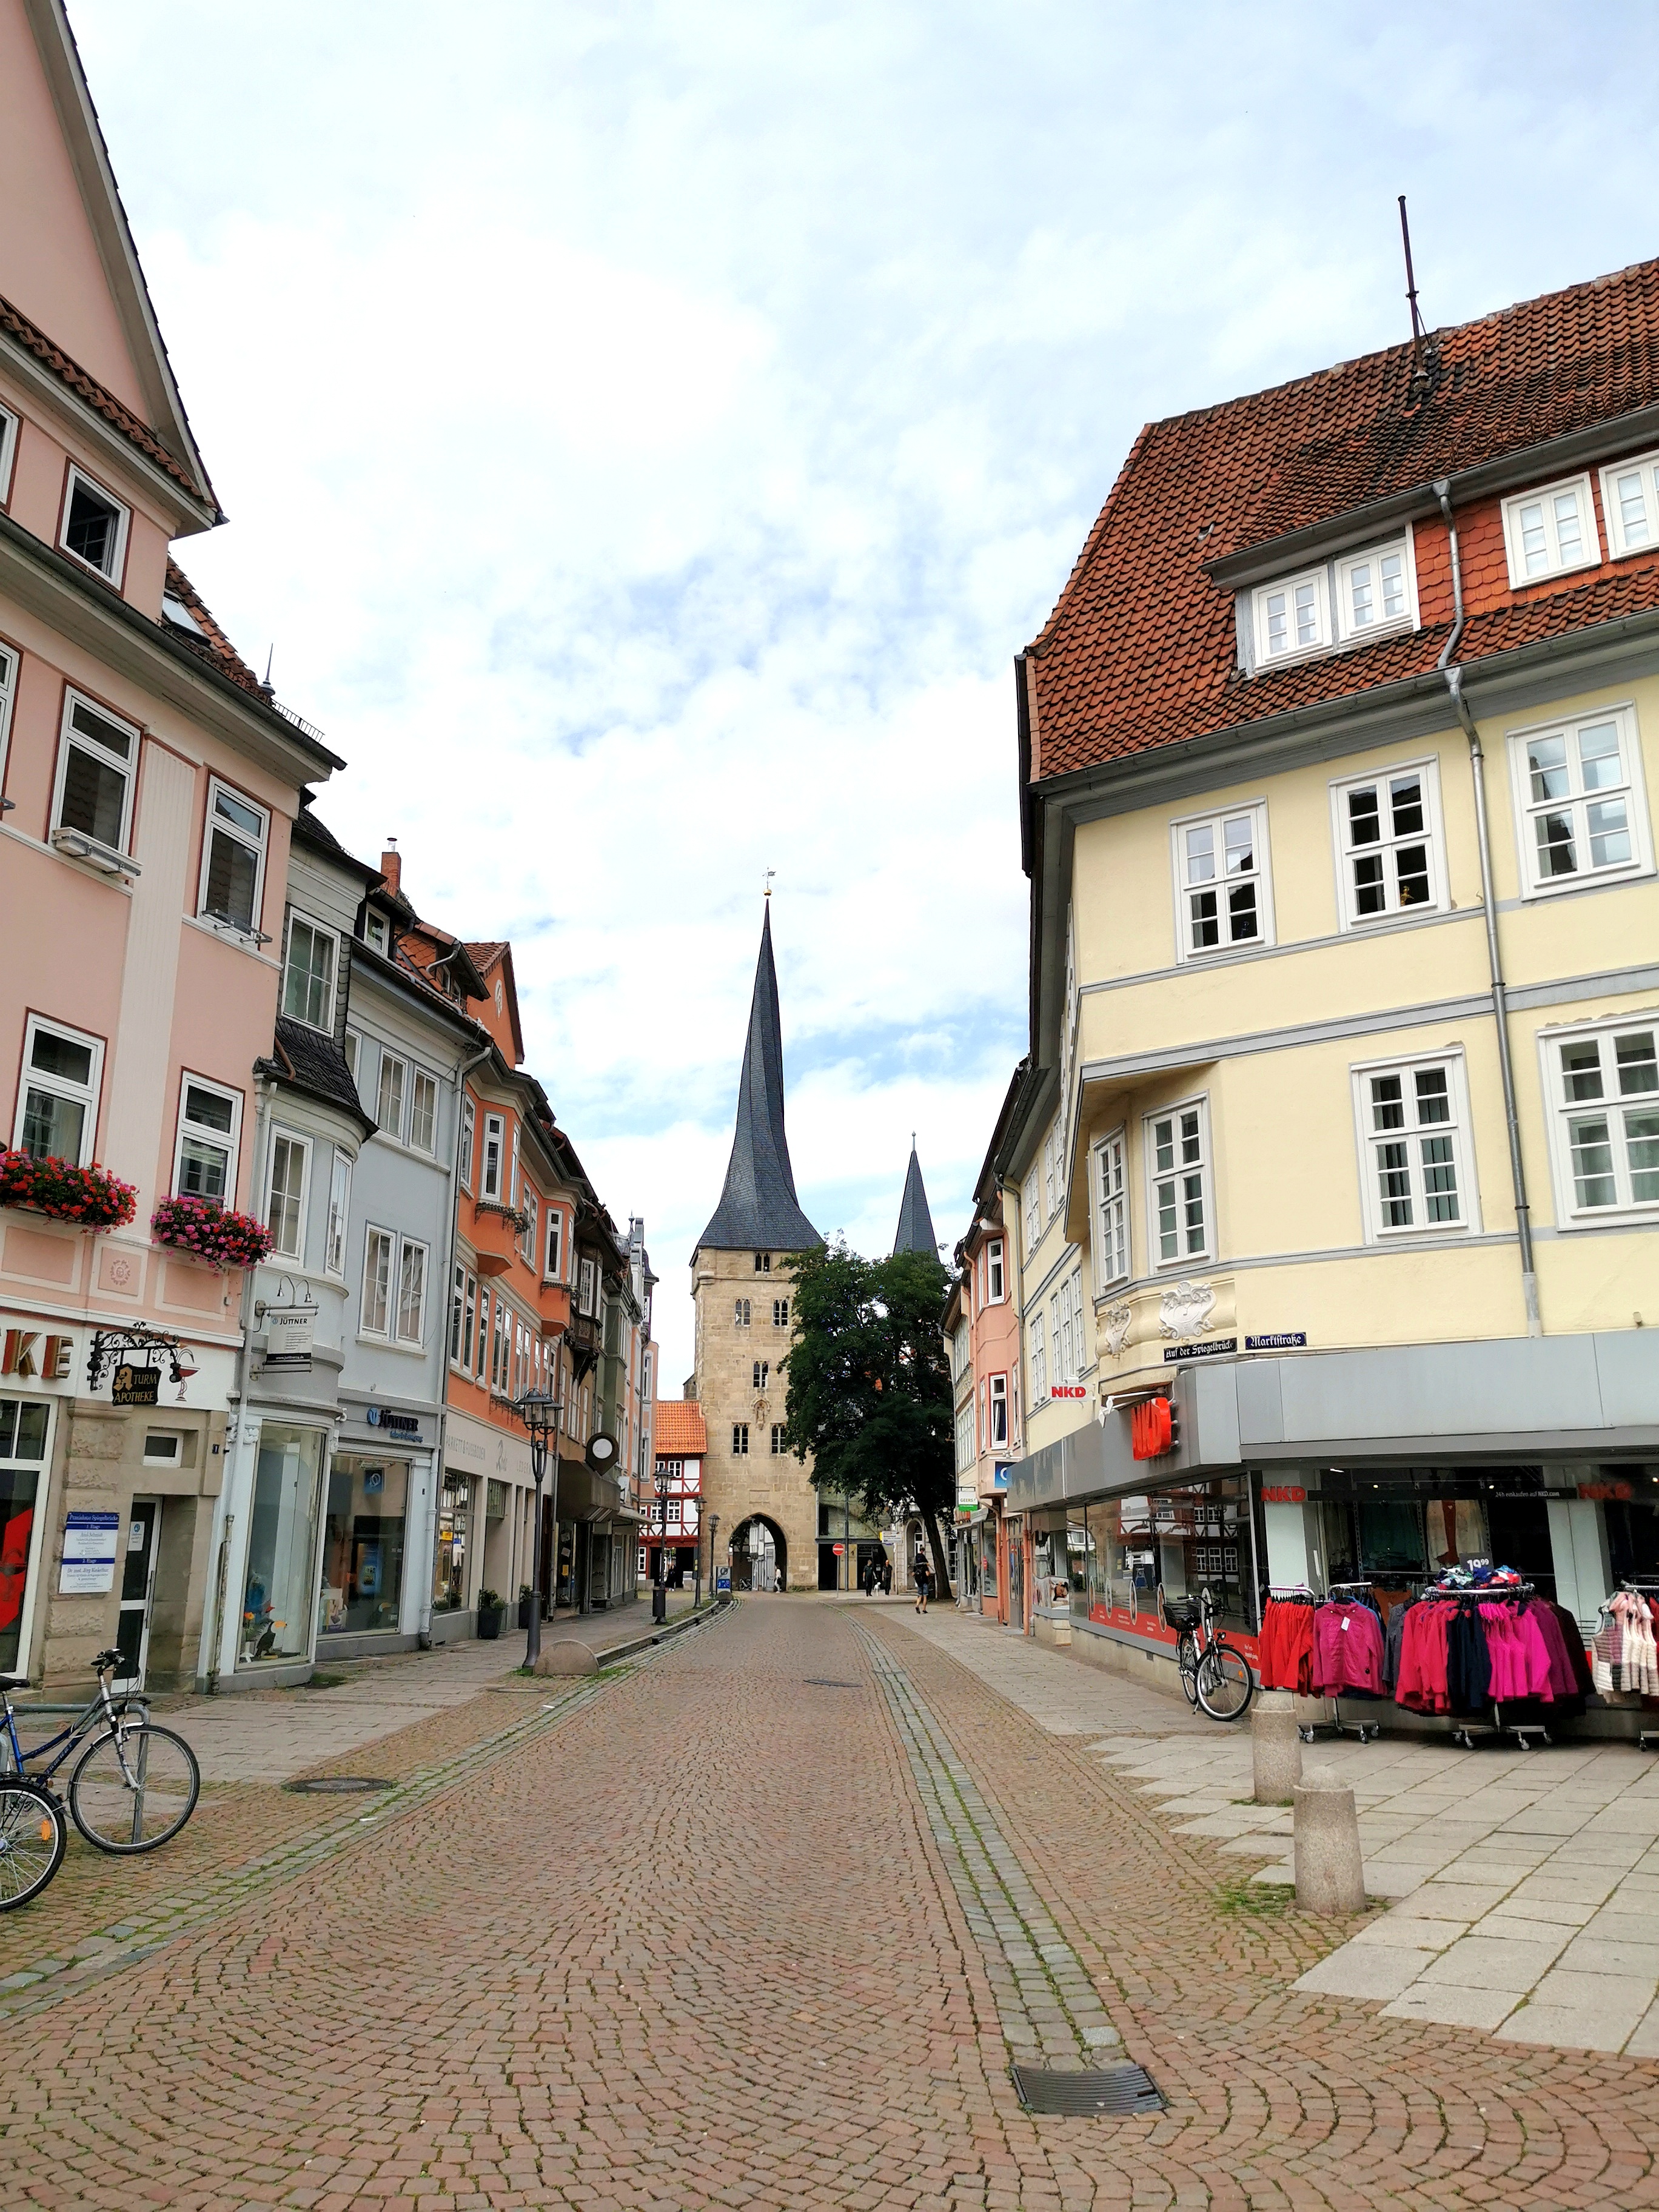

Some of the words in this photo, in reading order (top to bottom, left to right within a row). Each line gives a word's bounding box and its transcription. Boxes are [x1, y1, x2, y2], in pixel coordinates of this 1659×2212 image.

[280, 1317, 307, 1326] JÜTTNER
[1250, 1333, 1302, 1347] Marktstraße
[0, 1327, 74, 1379] KE
[1165, 1347, 1178, 1359] Auf
[1179, 1347, 1190, 1356] der
[1191, 1340, 1233, 1355] Spiegelbrücke
[133, 1373, 157, 1385] TURM
[113, 1391, 155, 1403] APOTHEKE
[1051, 1386, 1086, 1398] NKD
[1261, 1486, 1306, 1502] NKD
